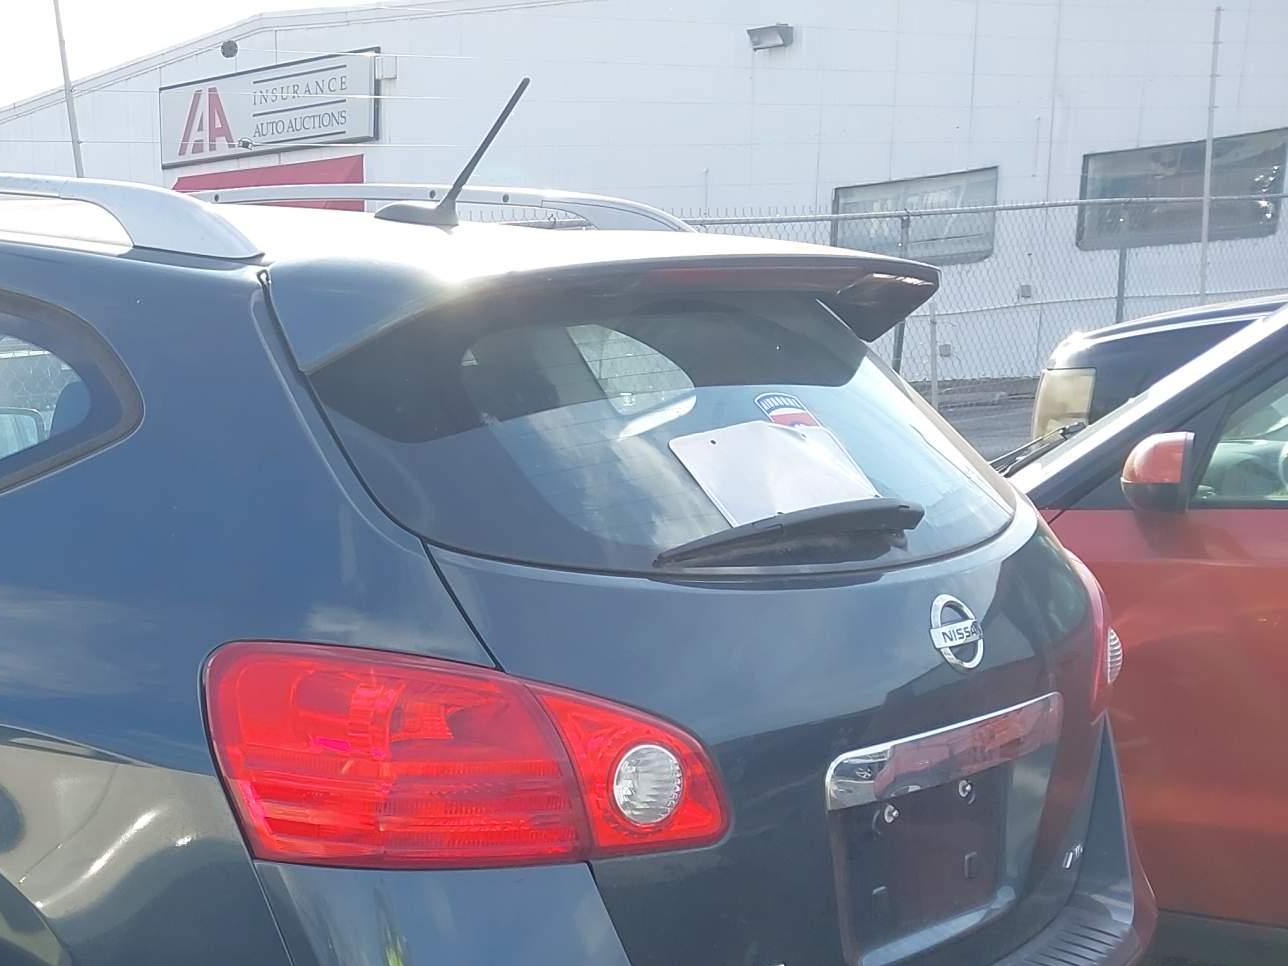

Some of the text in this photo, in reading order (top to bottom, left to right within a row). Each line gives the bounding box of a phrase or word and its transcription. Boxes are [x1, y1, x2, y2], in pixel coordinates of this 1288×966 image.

[252, 75, 348, 106] INSURANCE
[252, 110, 347, 138] AUTO AUCTIONS
